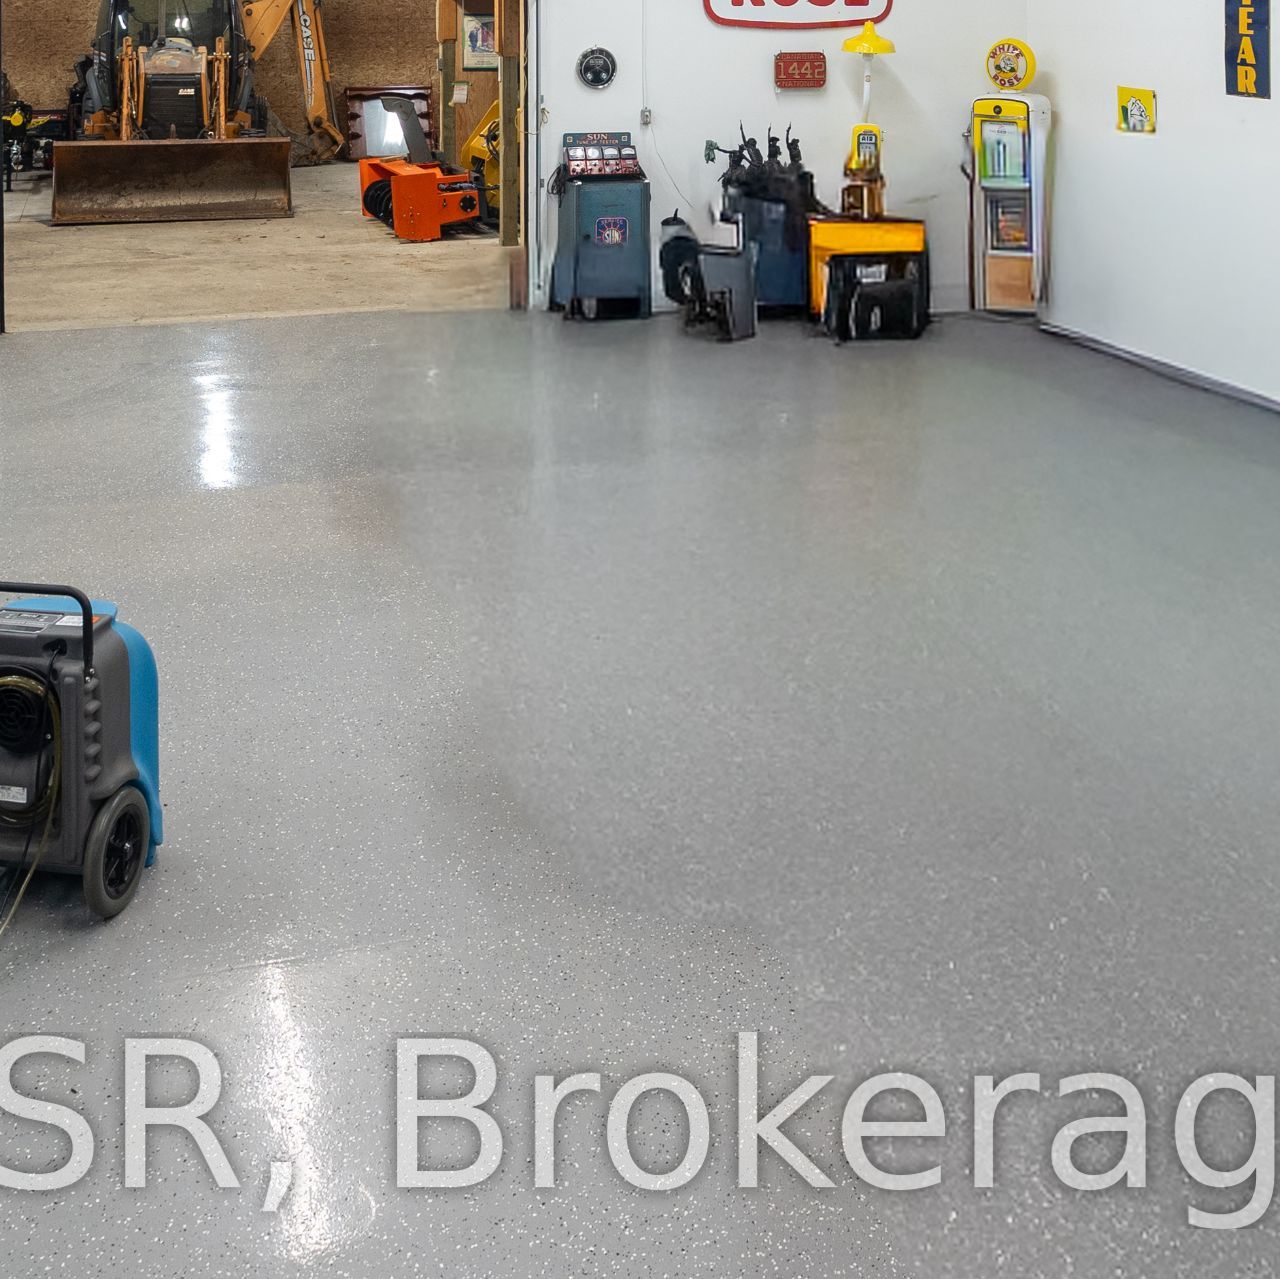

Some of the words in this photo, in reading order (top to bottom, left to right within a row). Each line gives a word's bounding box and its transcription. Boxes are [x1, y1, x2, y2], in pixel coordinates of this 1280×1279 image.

[300, 13, 316, 61] CASE
[990, 44, 1024, 60] WHITE
[777, 61, 826, 79] 1442
[992, 73, 1022, 87] ROSE
[587, 133, 608, 141] SUN
[605, 229, 621, 245] SUN
